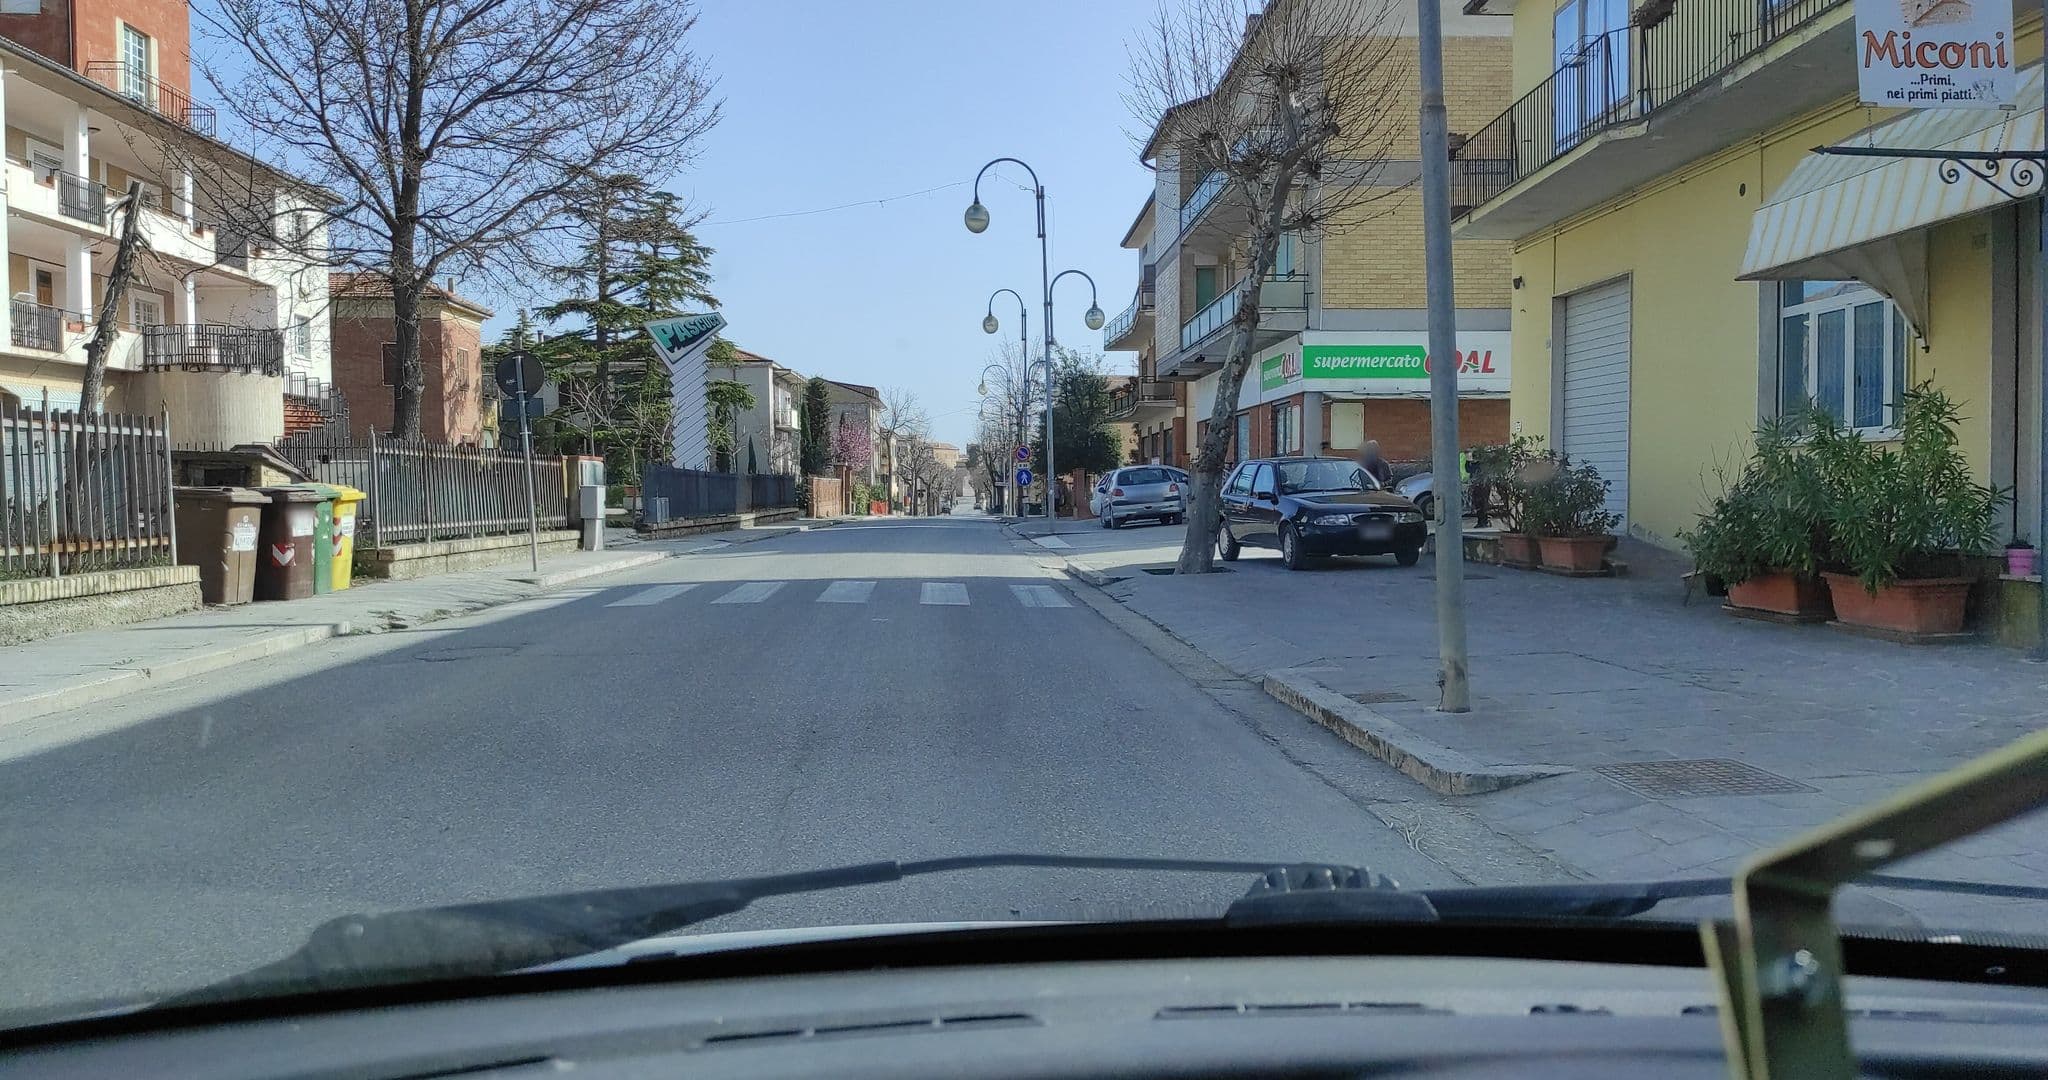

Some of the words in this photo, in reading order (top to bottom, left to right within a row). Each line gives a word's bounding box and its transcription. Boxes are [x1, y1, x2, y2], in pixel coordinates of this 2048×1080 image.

[1862, 30, 2008, 69] Miconi
[1887, 88, 1905, 99] nei
[1908, 88, 1938, 103] primi
[1941, 89, 1976, 103] piatti.
[1313, 354, 1421, 370] supermercato
[1424, 350, 1496, 374] AL
